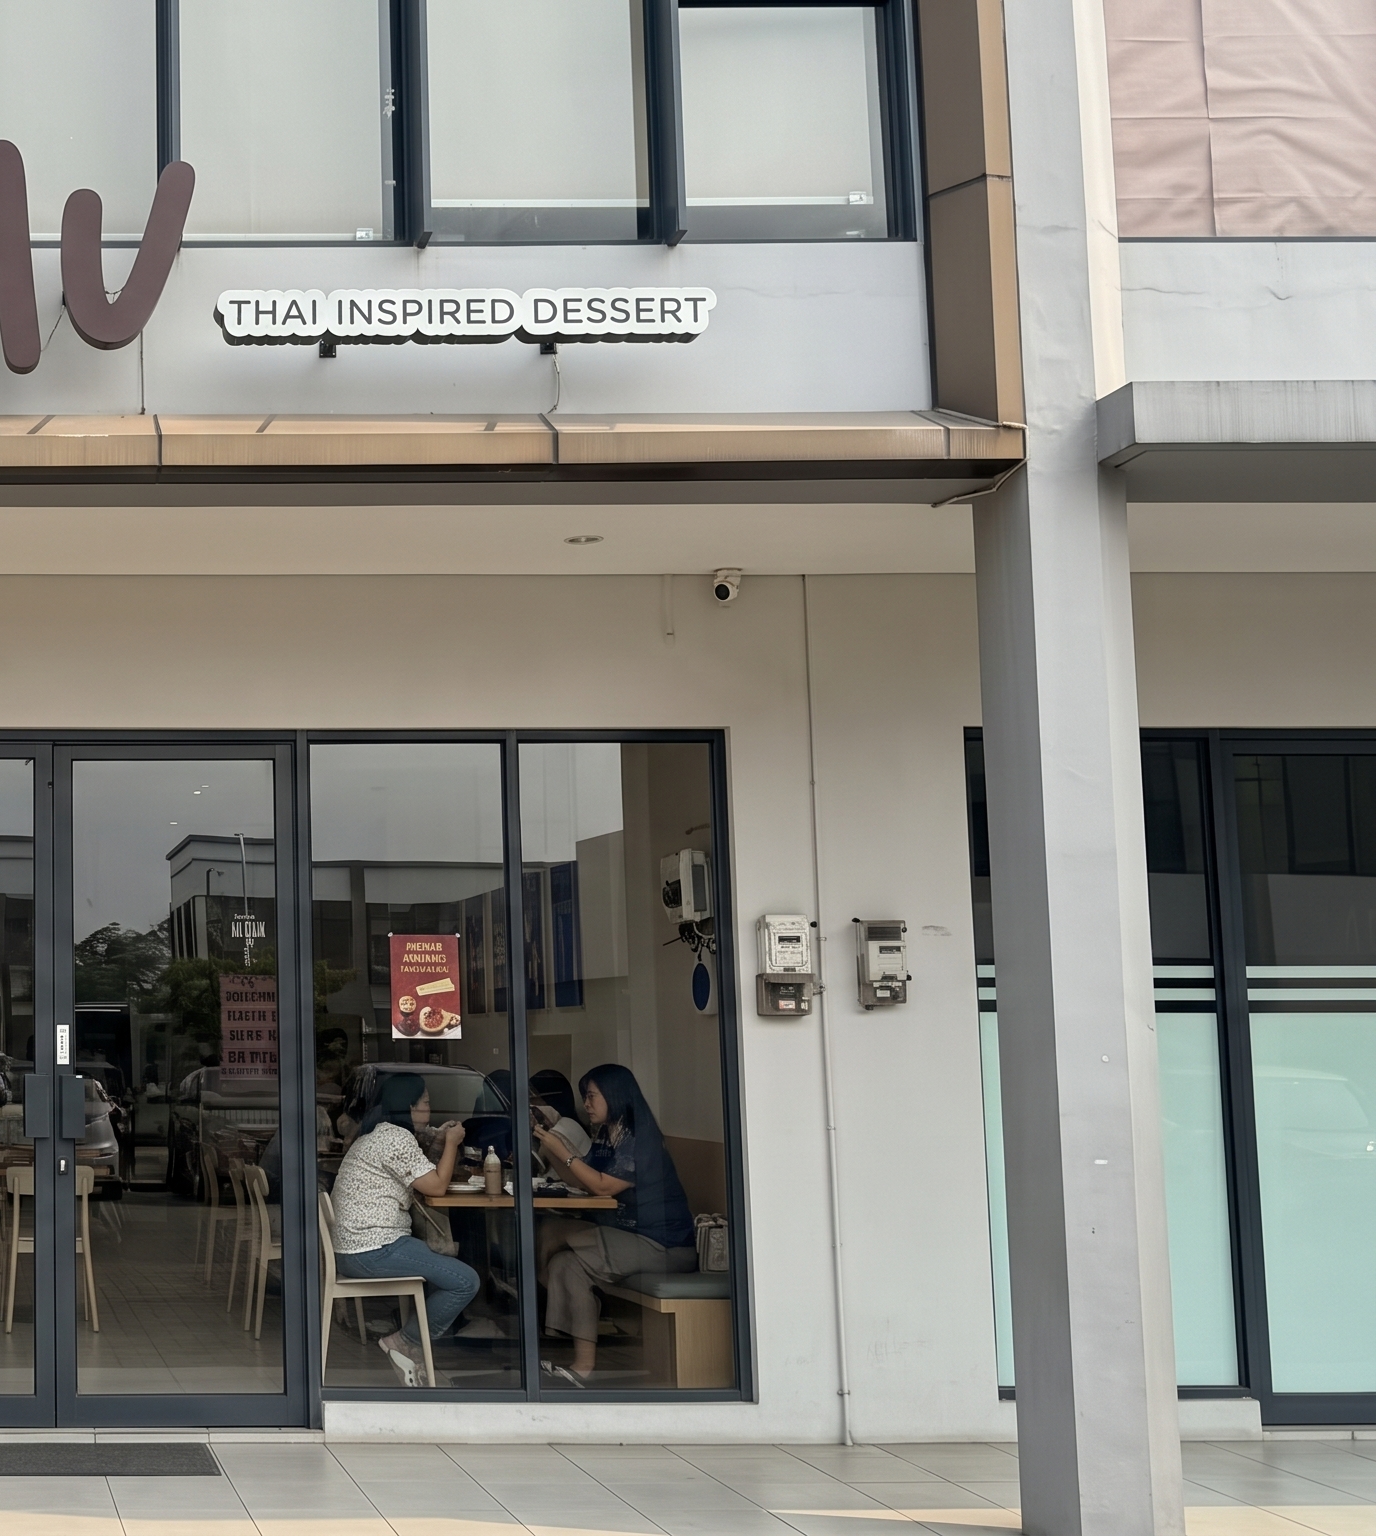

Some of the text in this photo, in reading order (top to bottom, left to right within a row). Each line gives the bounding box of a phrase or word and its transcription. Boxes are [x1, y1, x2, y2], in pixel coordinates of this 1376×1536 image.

[229, 297, 707, 326] THAI INSPIRED DESSERT
